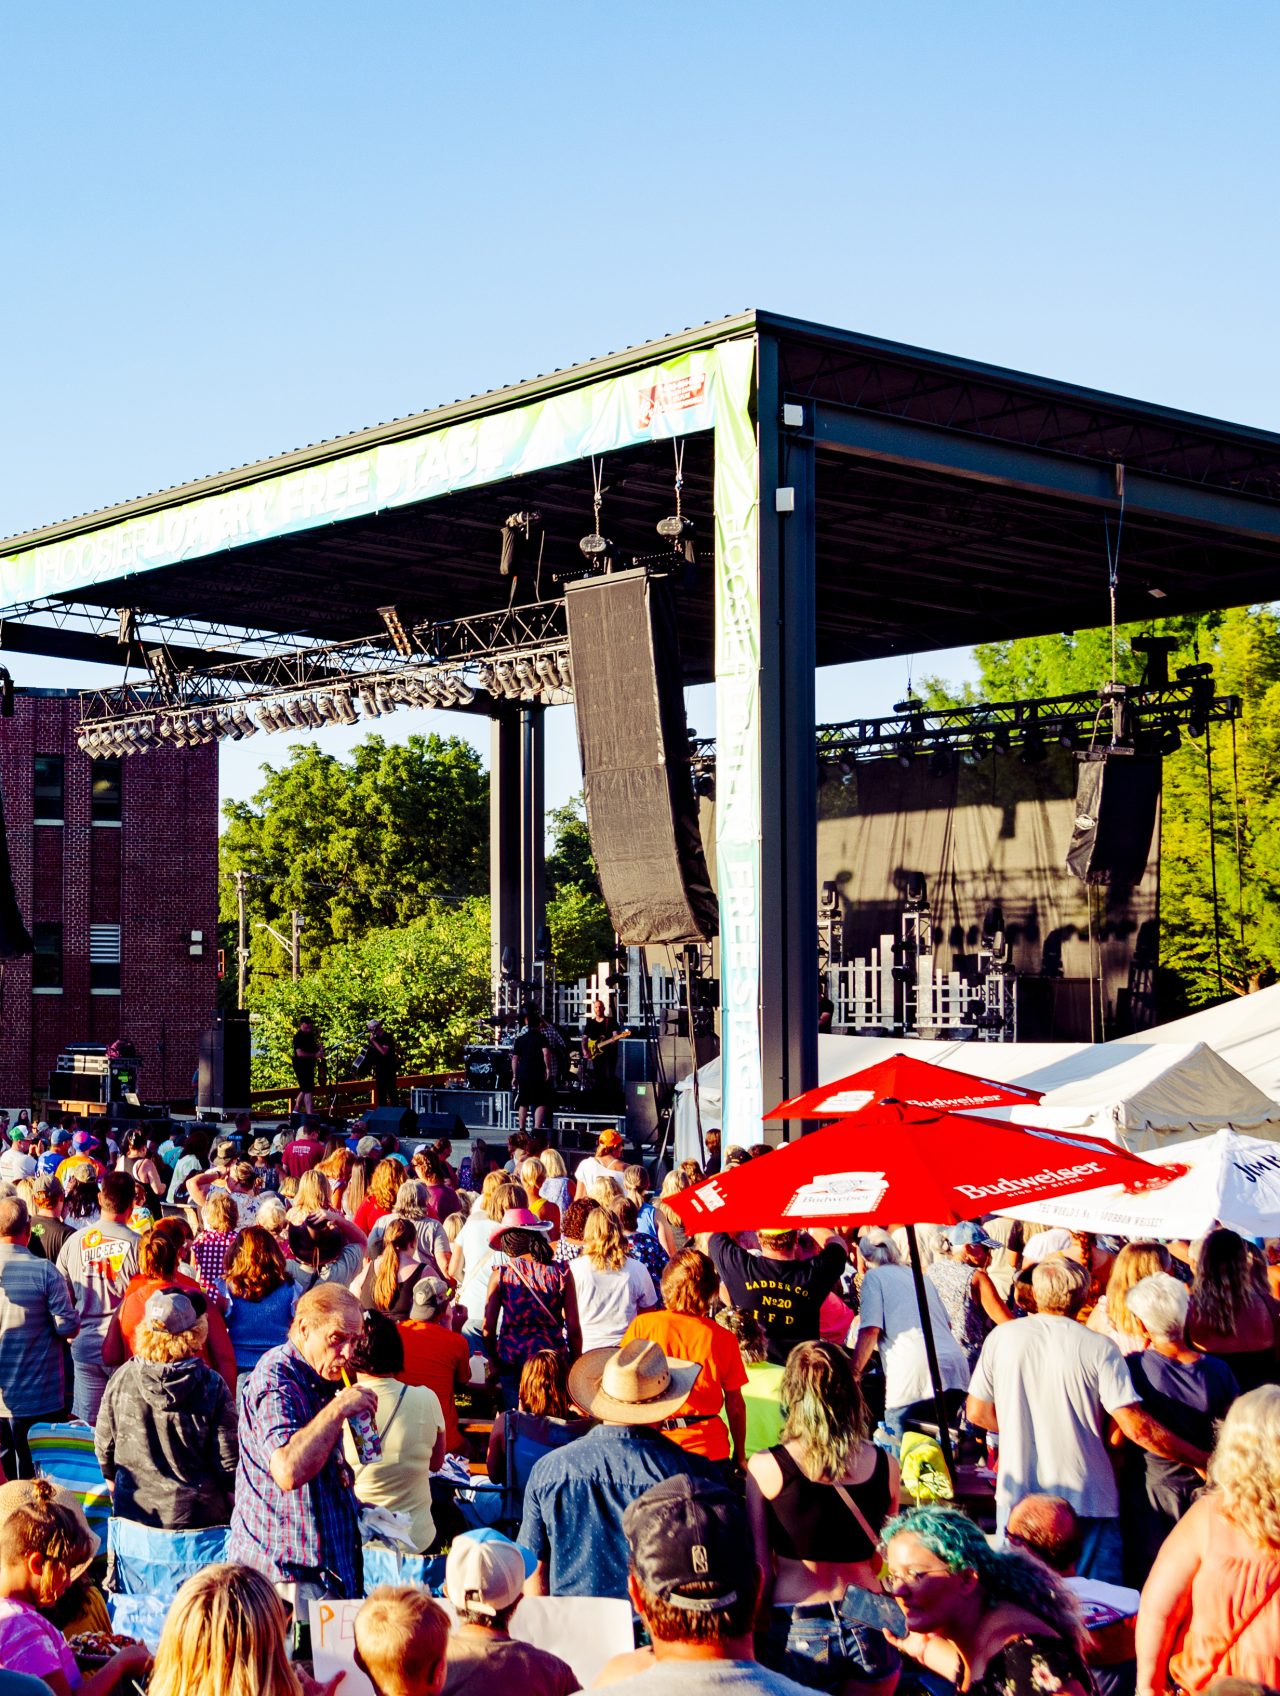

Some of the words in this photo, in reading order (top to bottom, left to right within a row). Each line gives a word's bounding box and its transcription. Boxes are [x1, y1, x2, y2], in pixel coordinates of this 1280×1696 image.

[276, 458, 370, 518] FREE
[376, 423, 506, 500] STAGE
[905, 1094, 1002, 1108] Budweiser
[952, 1161, 1102, 1200] Budweiser
[1233, 1160, 1272, 1183] JIM
[745, 1280, 791, 1291] LADDER
